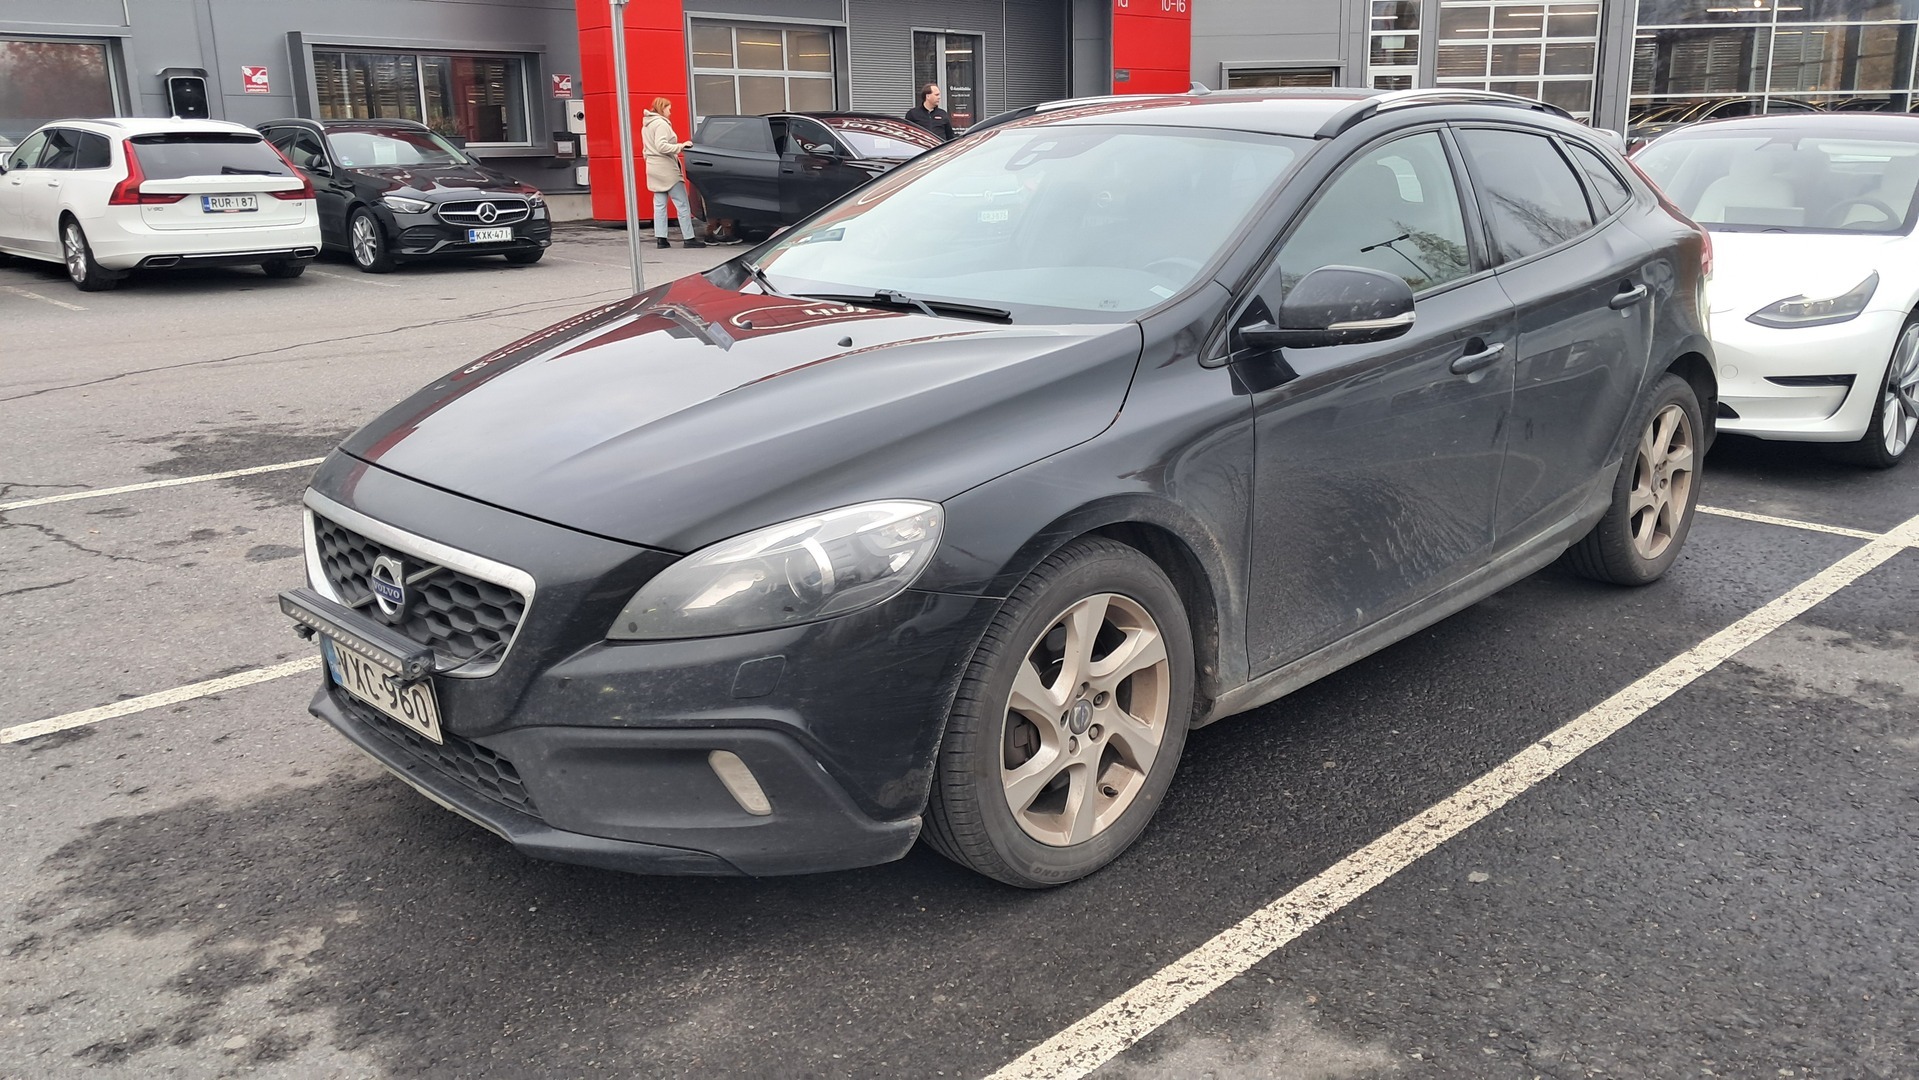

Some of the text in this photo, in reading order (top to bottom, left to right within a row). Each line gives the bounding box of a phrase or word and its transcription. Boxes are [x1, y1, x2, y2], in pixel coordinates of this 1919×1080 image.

[1161, 0, 1186, 13] 10-16
[211, 197, 253, 208] RUR-187
[476, 230, 508, 240] KXK-471
[373, 580, 400, 599] VOLVO
[335, 645, 430, 729] VXC-960
